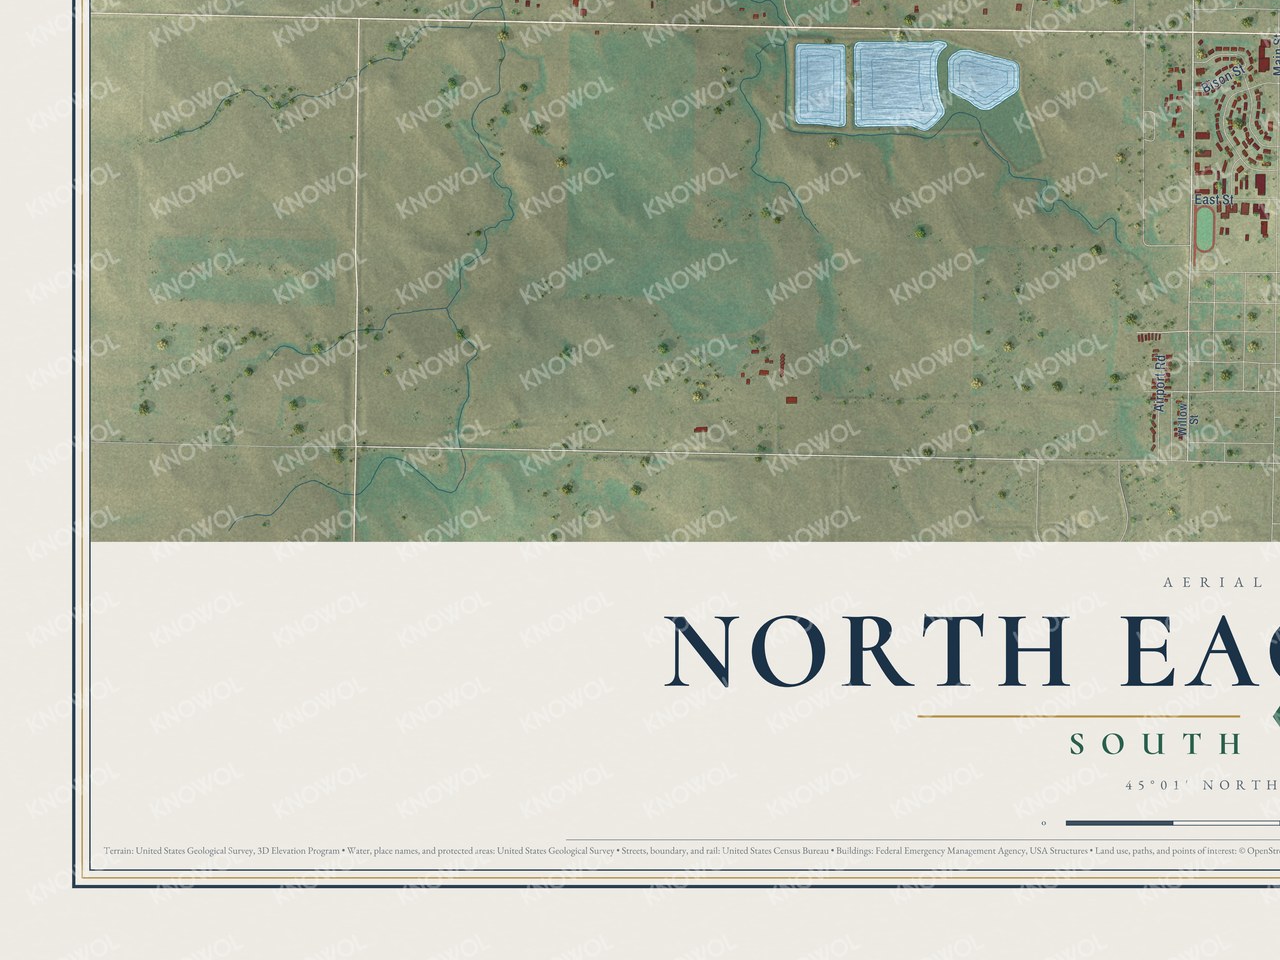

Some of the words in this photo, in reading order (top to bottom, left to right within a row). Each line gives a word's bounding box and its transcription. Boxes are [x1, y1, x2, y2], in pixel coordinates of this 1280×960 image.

[1201, 72, 1233, 93] Bison
[1232, 64, 1246, 77] St
[1195, 194, 1220, 205] East
[1222, 194, 1234, 205] St
[1154, 355, 1166, 370] Rd
[1154, 373, 1165, 412] Airport
[1177, 403, 1187, 436] Willow
[1189, 415, 1199, 425] St
[1163, 576, 1262, 588] AERIAL
[664, 614, 1071, 688] NORTH
[1070, 732, 1242, 756] SOUTH
[1203, 779, 1279, 791] NORTH
[104, 846, 133, 855] Terrain:
[136, 846, 162, 855] United
[164, 846, 185, 855] States
[187, 846, 226, 858] Geological
[228, 846, 255, 858] Survey,
[258, 846, 269, 855] 3D
[272, 846, 306, 855] Elevation
[308, 846, 339, 858] Program
[347, 846, 372, 856] Water,
[374, 846, 393, 858] place
[422, 846, 436, 855] and
[438, 846, 473, 858] protected
[497, 846, 523, 855] United
[525, 846, 546, 855] States
[549, 846, 587, 858] Geological
[590, 846, 614, 857] Survey
[622, 846, 648, 855] Streets,
[650, 846, 688, 858] boundary,
[691, 846, 704, 855] and
[706, 846, 720, 855] rail:
[723, 846, 748, 855] United
[750, 846, 771, 855] States
[774, 846, 800, 855] Census
[803, 846, 828, 855] Bureau
[837, 846, 873, 858] Buildings:
[876, 846, 902, 855] Federal
[905, 846, 945, 858] Emergency
[947, 846, 996, 858] Management
[998, 846, 1027, 858] Agency,
[1030, 846, 1048, 855] USA
[1050, 846, 1088, 855] Structures
[1096, 846, 1114, 855] Land
[1117, 848, 1130, 856] use,
[1133, 846, 1154, 858] paths,
[1157, 846, 1170, 855] and
[1172, 847, 1196, 858] points
[1198, 846, 1206, 855] of
[1208, 847, 1236, 855] interest:
